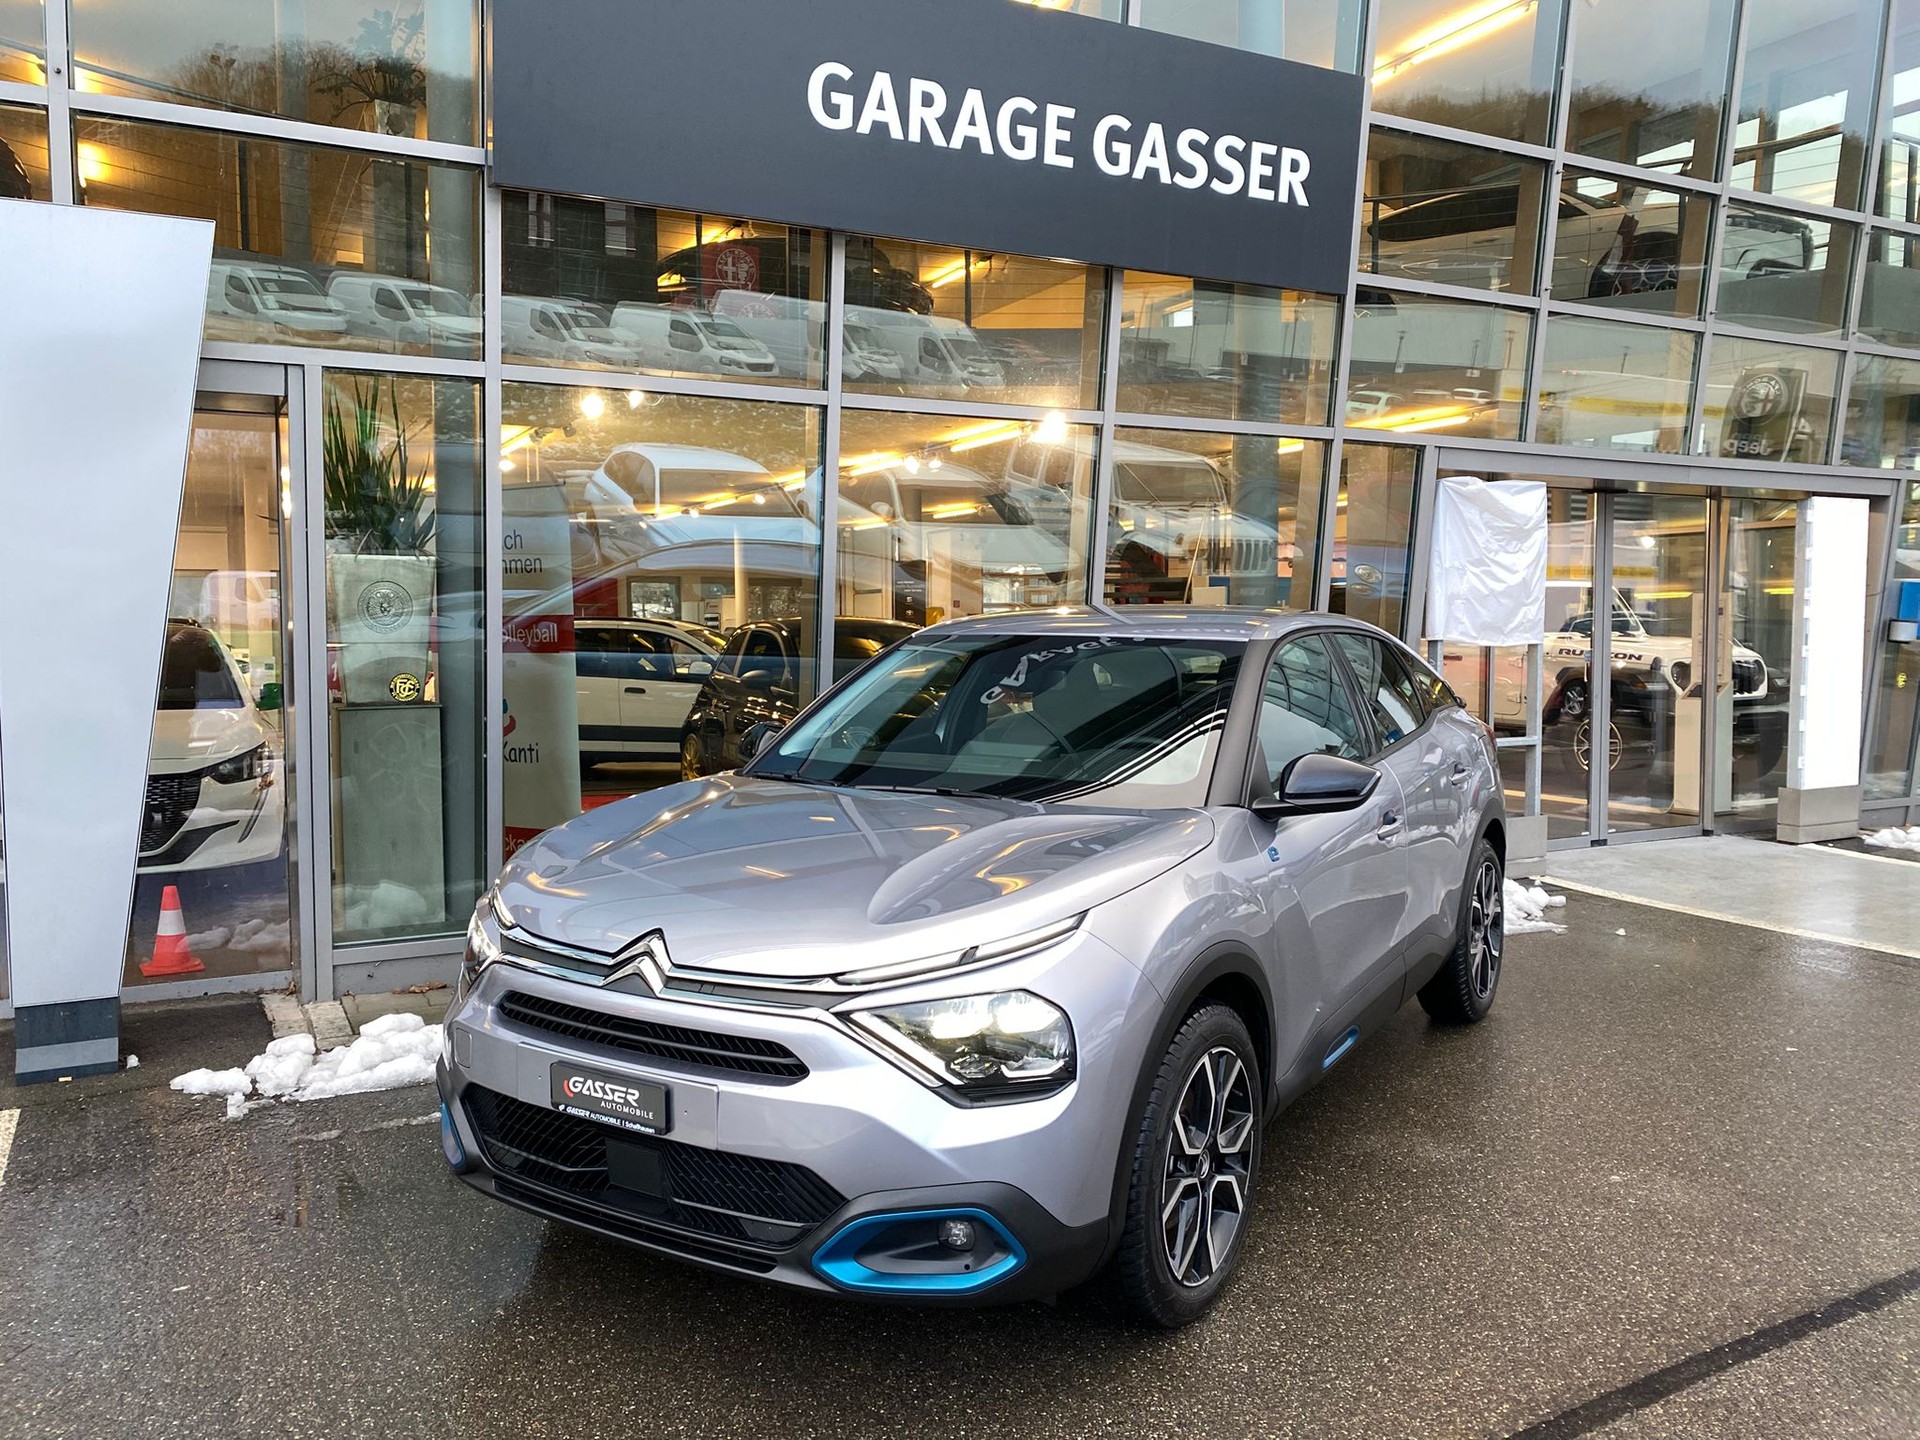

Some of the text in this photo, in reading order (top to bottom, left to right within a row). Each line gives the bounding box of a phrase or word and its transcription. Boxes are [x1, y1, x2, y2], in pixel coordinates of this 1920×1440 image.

[806, 61, 1311, 207] GARAGE GASSER
[1558, 648, 1643, 661] RUON
[568, 1076, 640, 1107] GASSER
[590, 1112, 621, 1126] AUTOMOBILE
[600, 1100, 654, 1120] AUTOMOBILE
